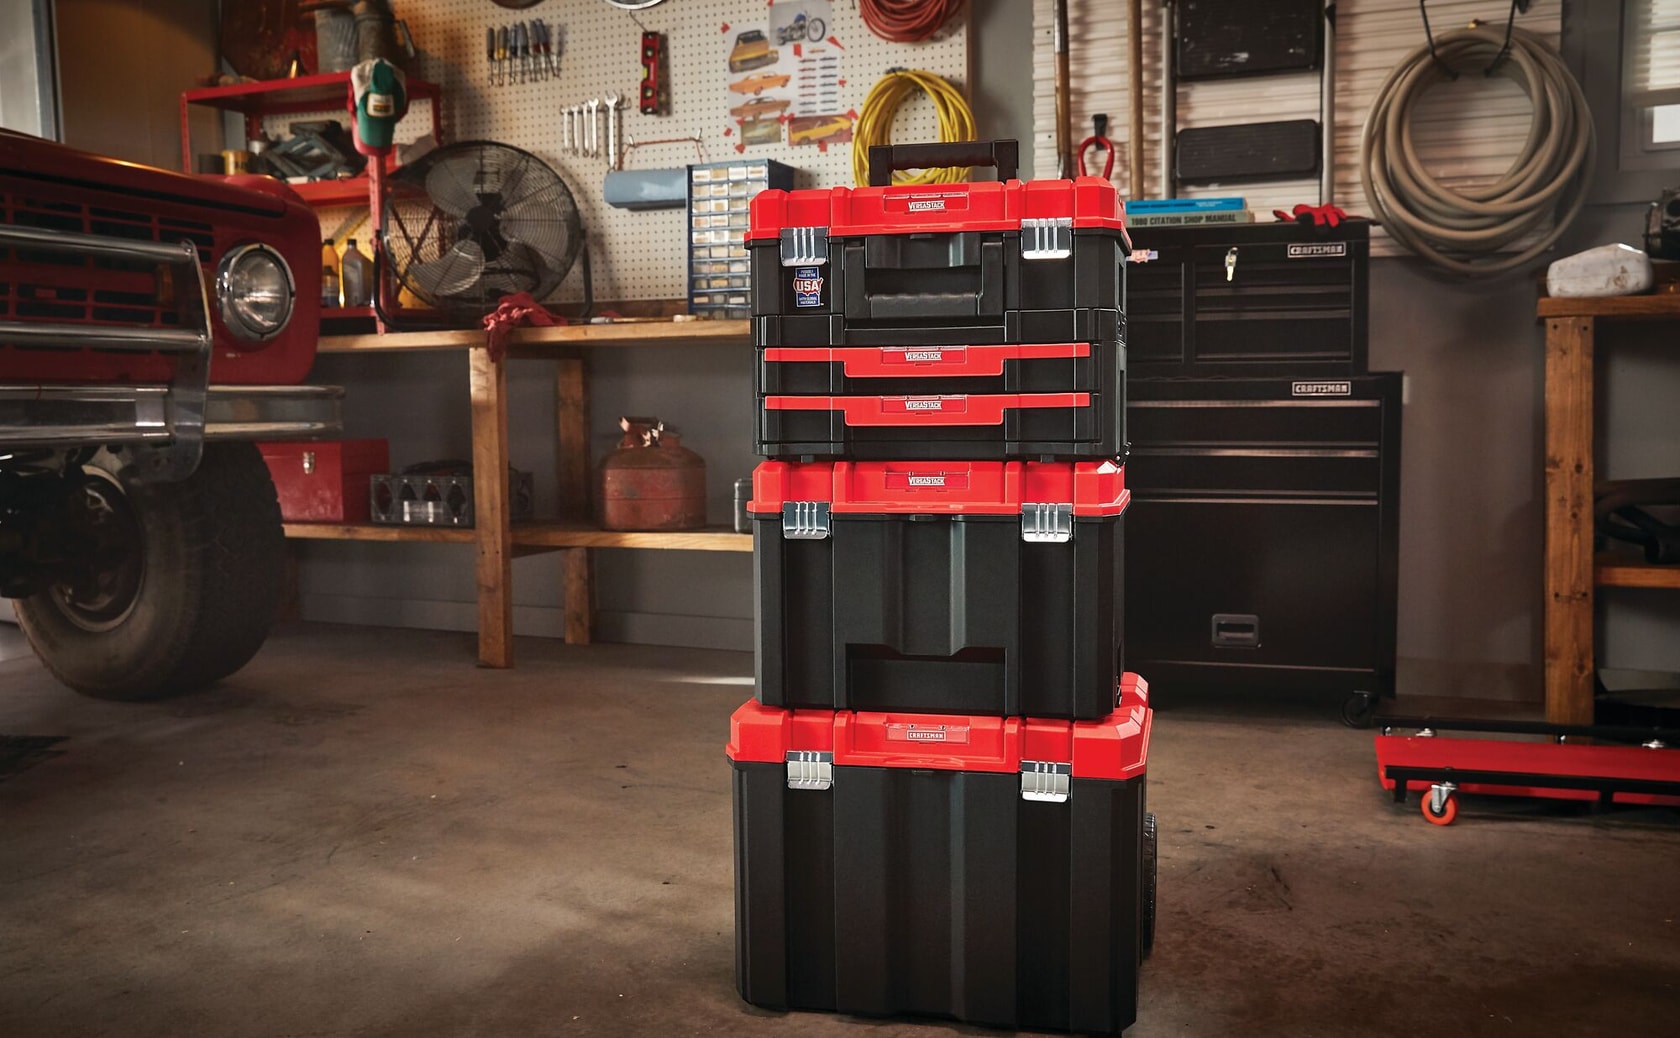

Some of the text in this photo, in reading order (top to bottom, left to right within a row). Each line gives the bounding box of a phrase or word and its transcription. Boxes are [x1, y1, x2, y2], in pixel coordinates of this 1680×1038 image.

[1149, 216, 1182, 225] CITATION
[1184, 215, 1204, 224] SHOP
[1205, 214, 1236, 222] MANUAL
[1290, 245, 1343, 255] CRAFTSMAN
[796, 280, 819, 291] USA
[1295, 384, 1348, 393] CRAFTSMAN
